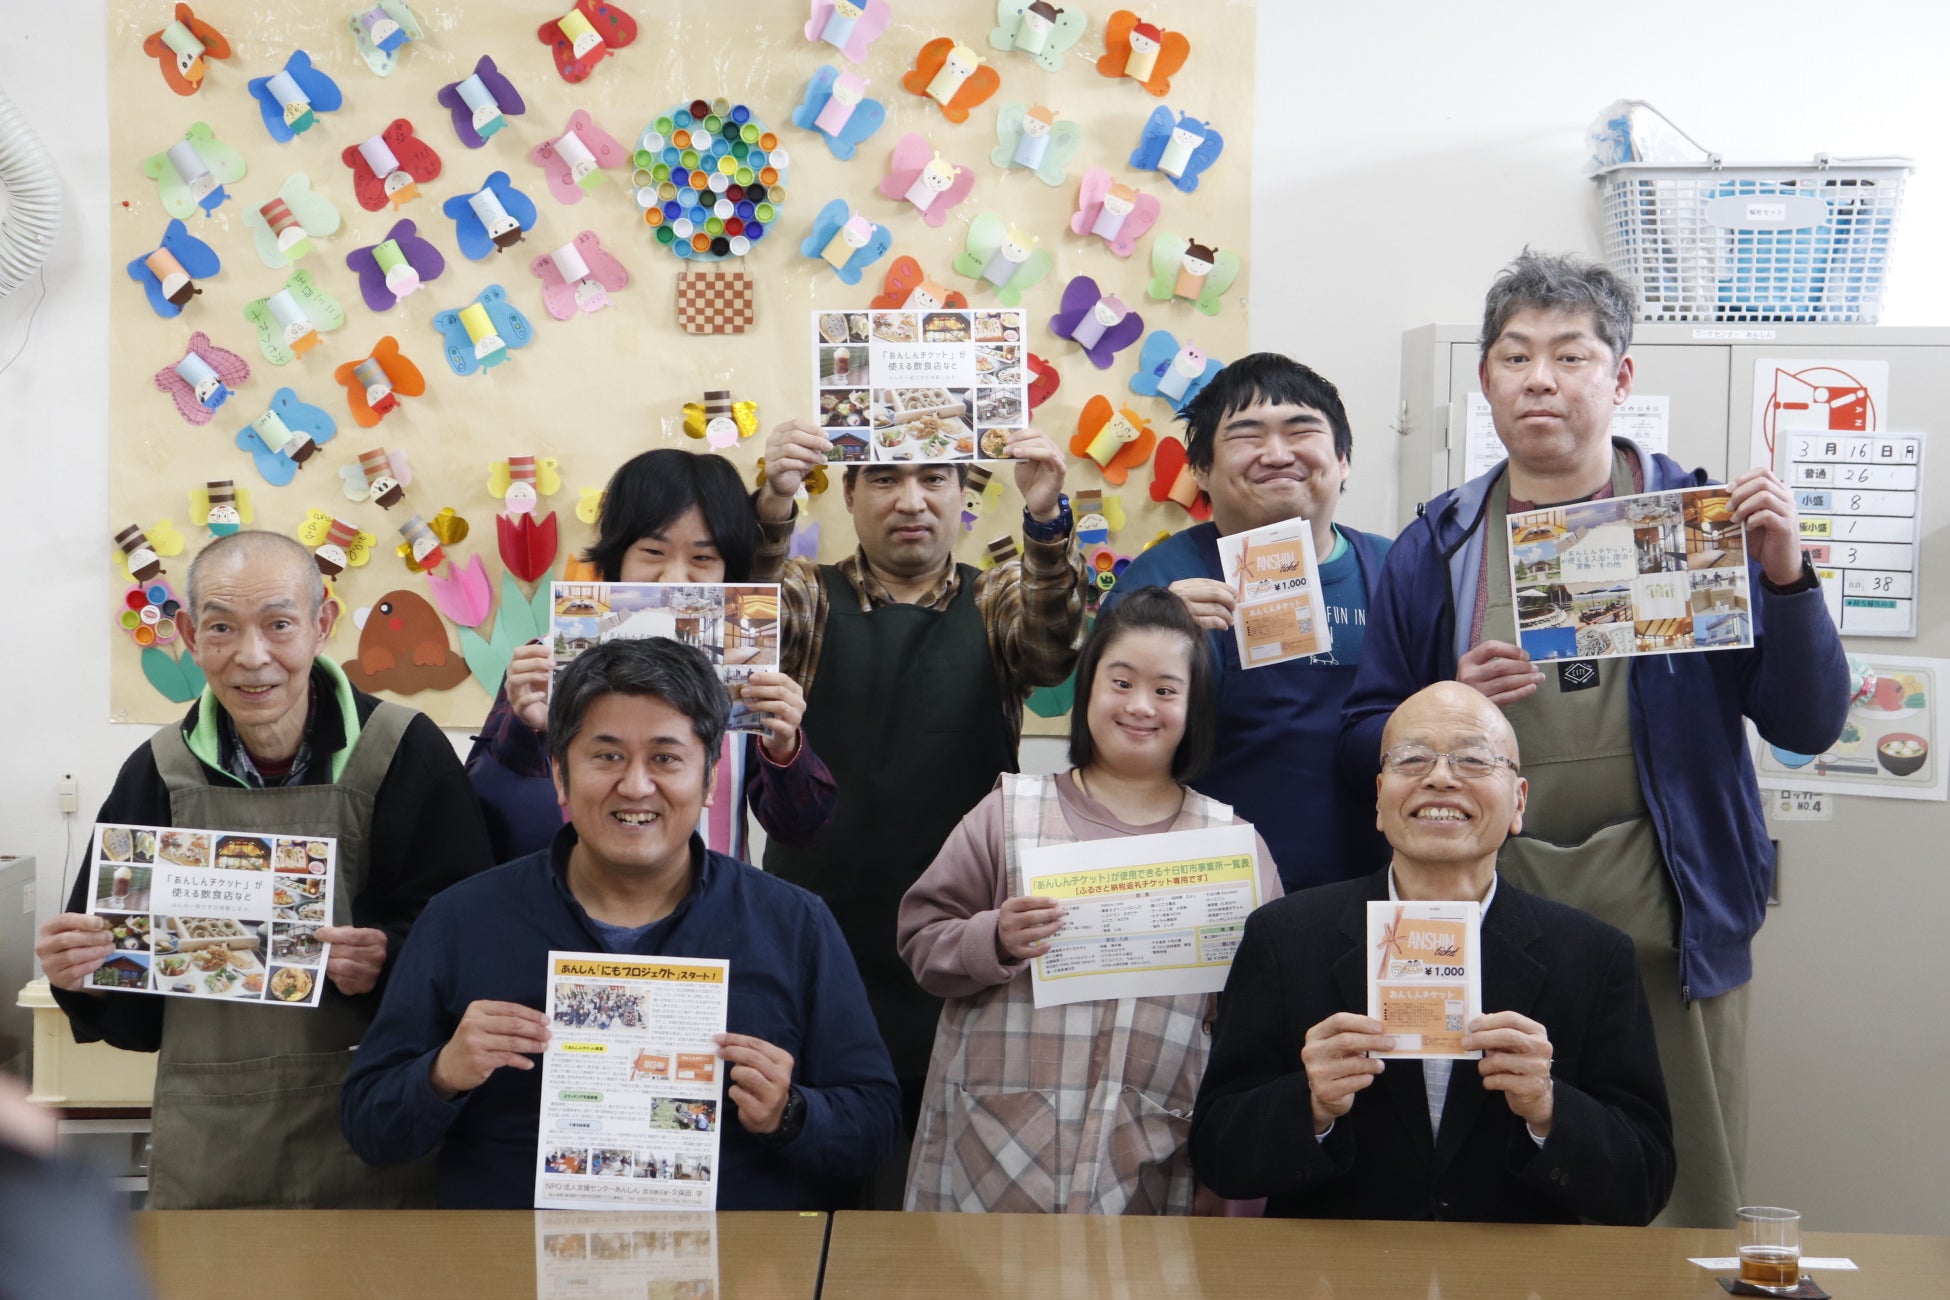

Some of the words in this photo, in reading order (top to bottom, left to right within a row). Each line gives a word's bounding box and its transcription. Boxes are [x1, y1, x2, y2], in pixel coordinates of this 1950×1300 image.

[888, 362, 957, 371] 使える飲食店など
[1825, 442, 1837, 456] 月
[1850, 443, 1868, 458] 16
[1881, 445, 1893, 458] 日
[1804, 468, 1826, 480] 普通
[1845, 468, 1869, 483] 26
[1802, 495, 1824, 507] 小盛
[1850, 494, 1861, 511] 8
[1256, 551, 1296, 572] ANSHIN
[1848, 548, 1858, 563] 3
[1872, 577, 1894, 592] 38
[1354, 608, 1366, 625] IN
[167, 874, 263, 890] 「あんしんチケット」が
[172, 887, 252, 902] 使える飲食店など
[1407, 930, 1456, 950] ANSHIN
[1434, 945, 1460, 957] ticket
[545, 1183, 562, 1191] NPO
